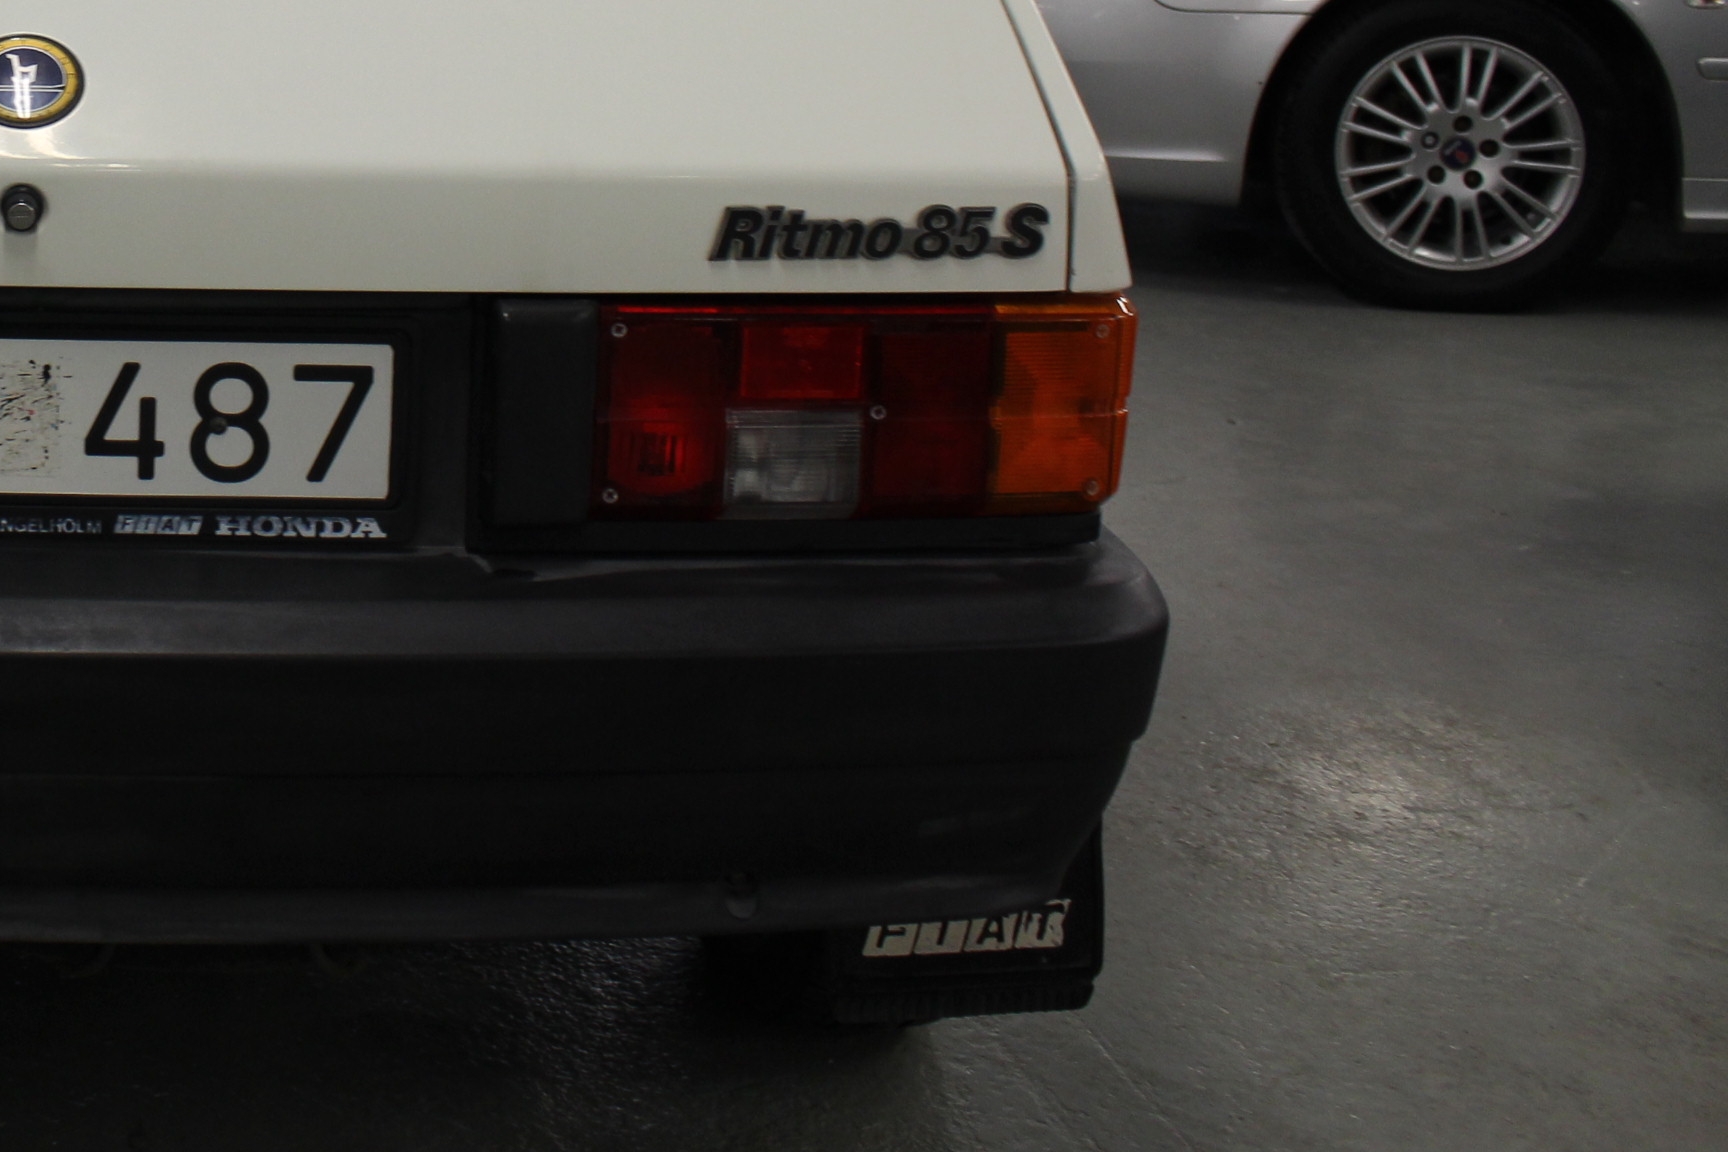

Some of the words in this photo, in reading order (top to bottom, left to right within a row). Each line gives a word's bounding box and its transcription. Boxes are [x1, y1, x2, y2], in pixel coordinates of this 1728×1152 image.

[708, 205, 903, 261] Ritmo
[83, 361, 375, 484] 487
[113, 514, 205, 536] FIAT
[214, 515, 388, 539] HONDA
